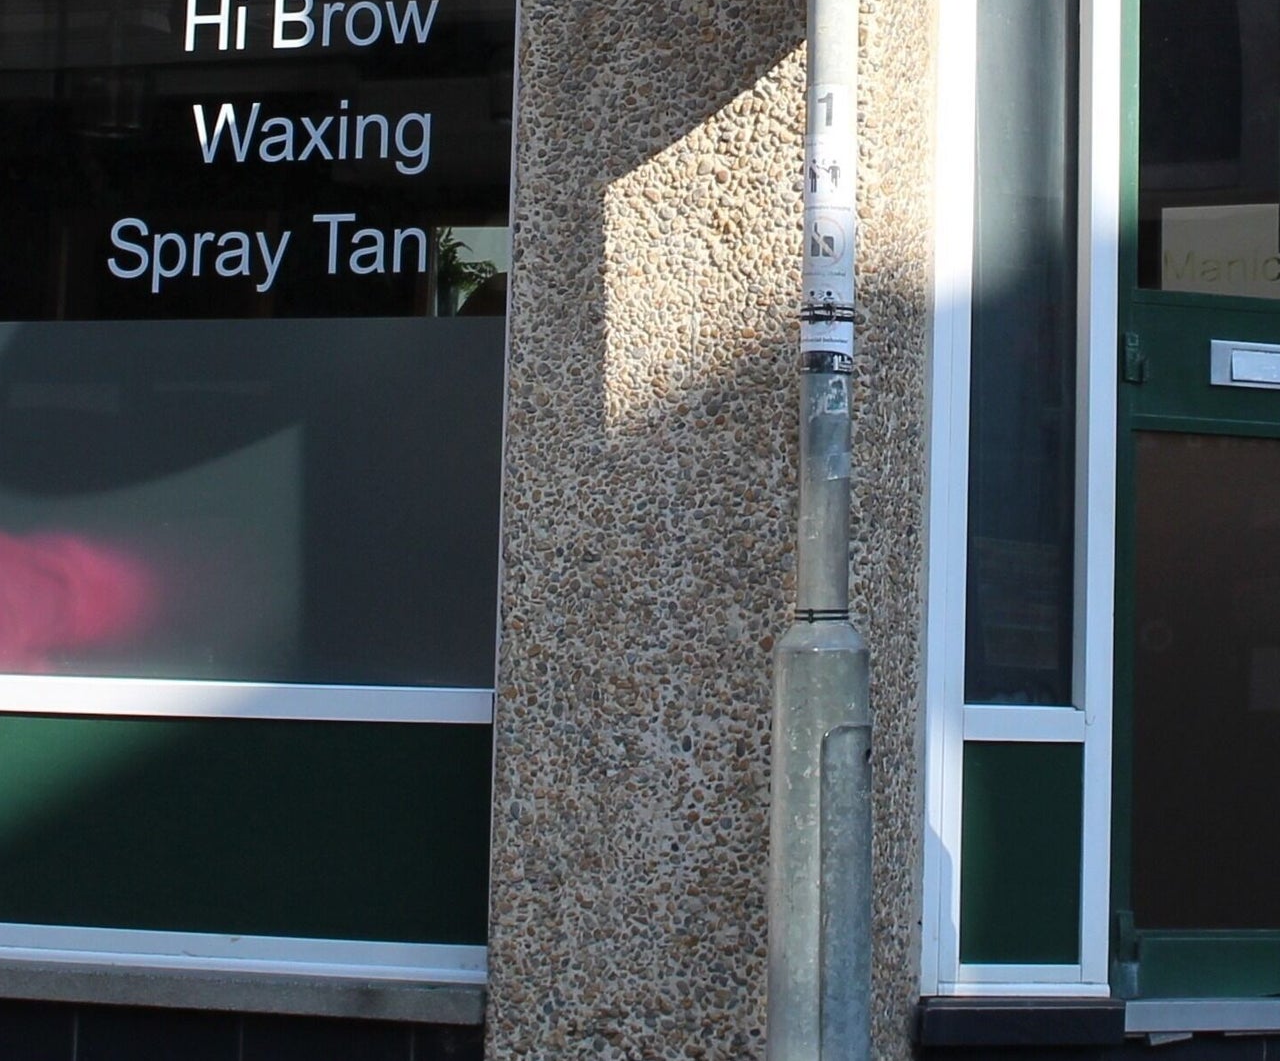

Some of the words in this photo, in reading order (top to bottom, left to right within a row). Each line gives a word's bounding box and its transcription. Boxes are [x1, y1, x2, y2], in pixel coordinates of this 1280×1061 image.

[193, 99, 432, 175] Waxing
[817, 92, 835, 127] 1
[107, 217, 292, 293] Spray
[313, 213, 427, 274] Tan
